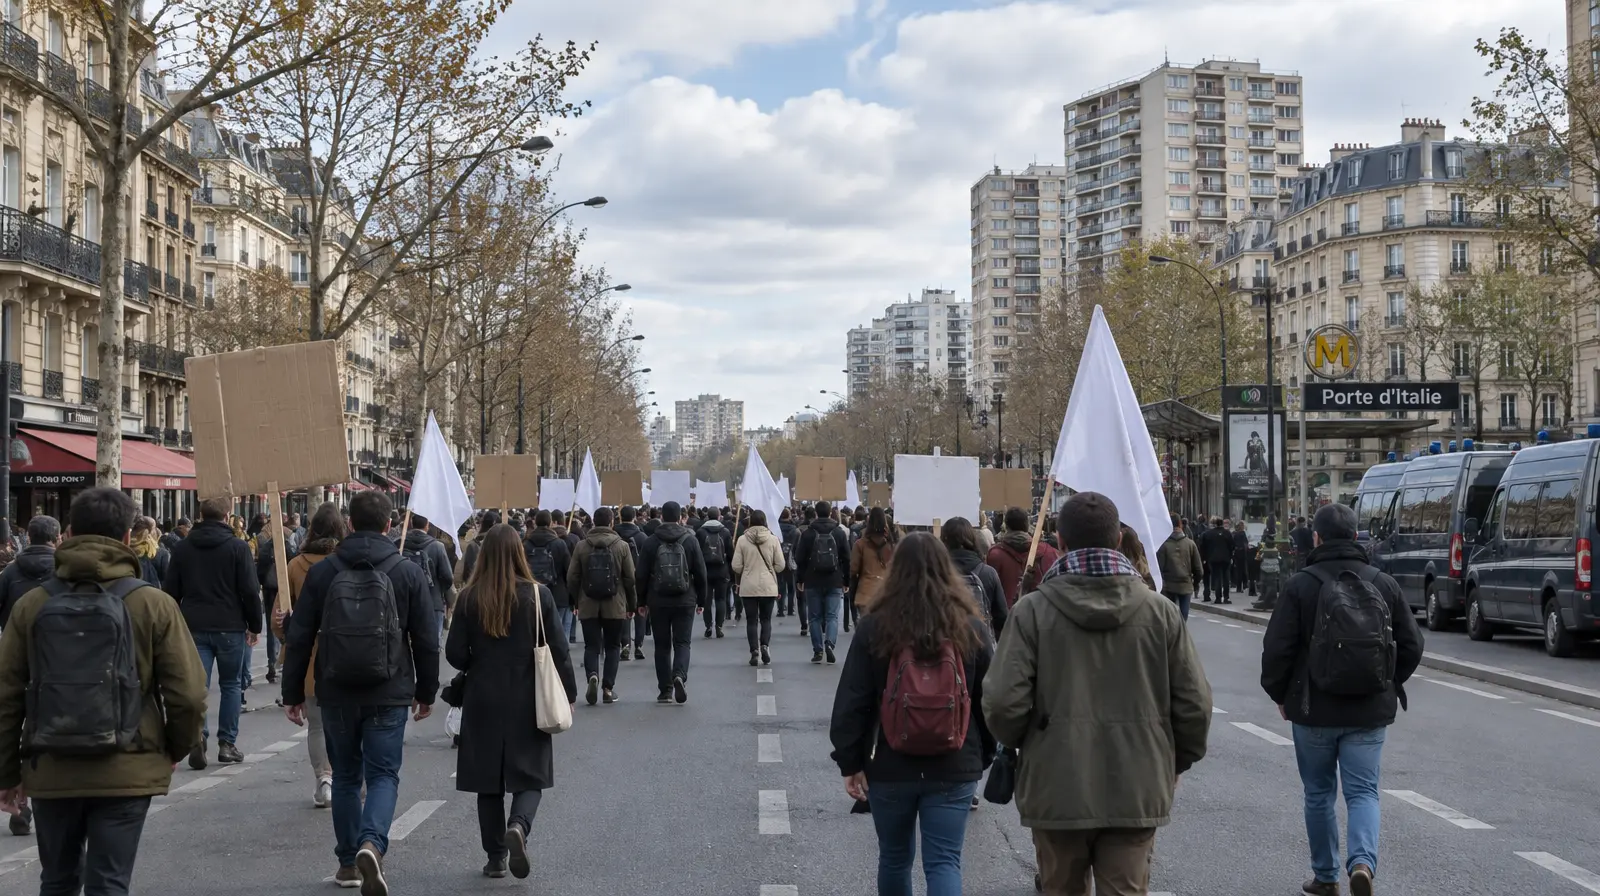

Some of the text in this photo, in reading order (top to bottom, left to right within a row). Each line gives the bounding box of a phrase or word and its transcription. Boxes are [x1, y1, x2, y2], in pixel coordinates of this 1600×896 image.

[1315, 335, 1350, 368] M
[1322, 388, 1442, 405] Porte d'Italie
